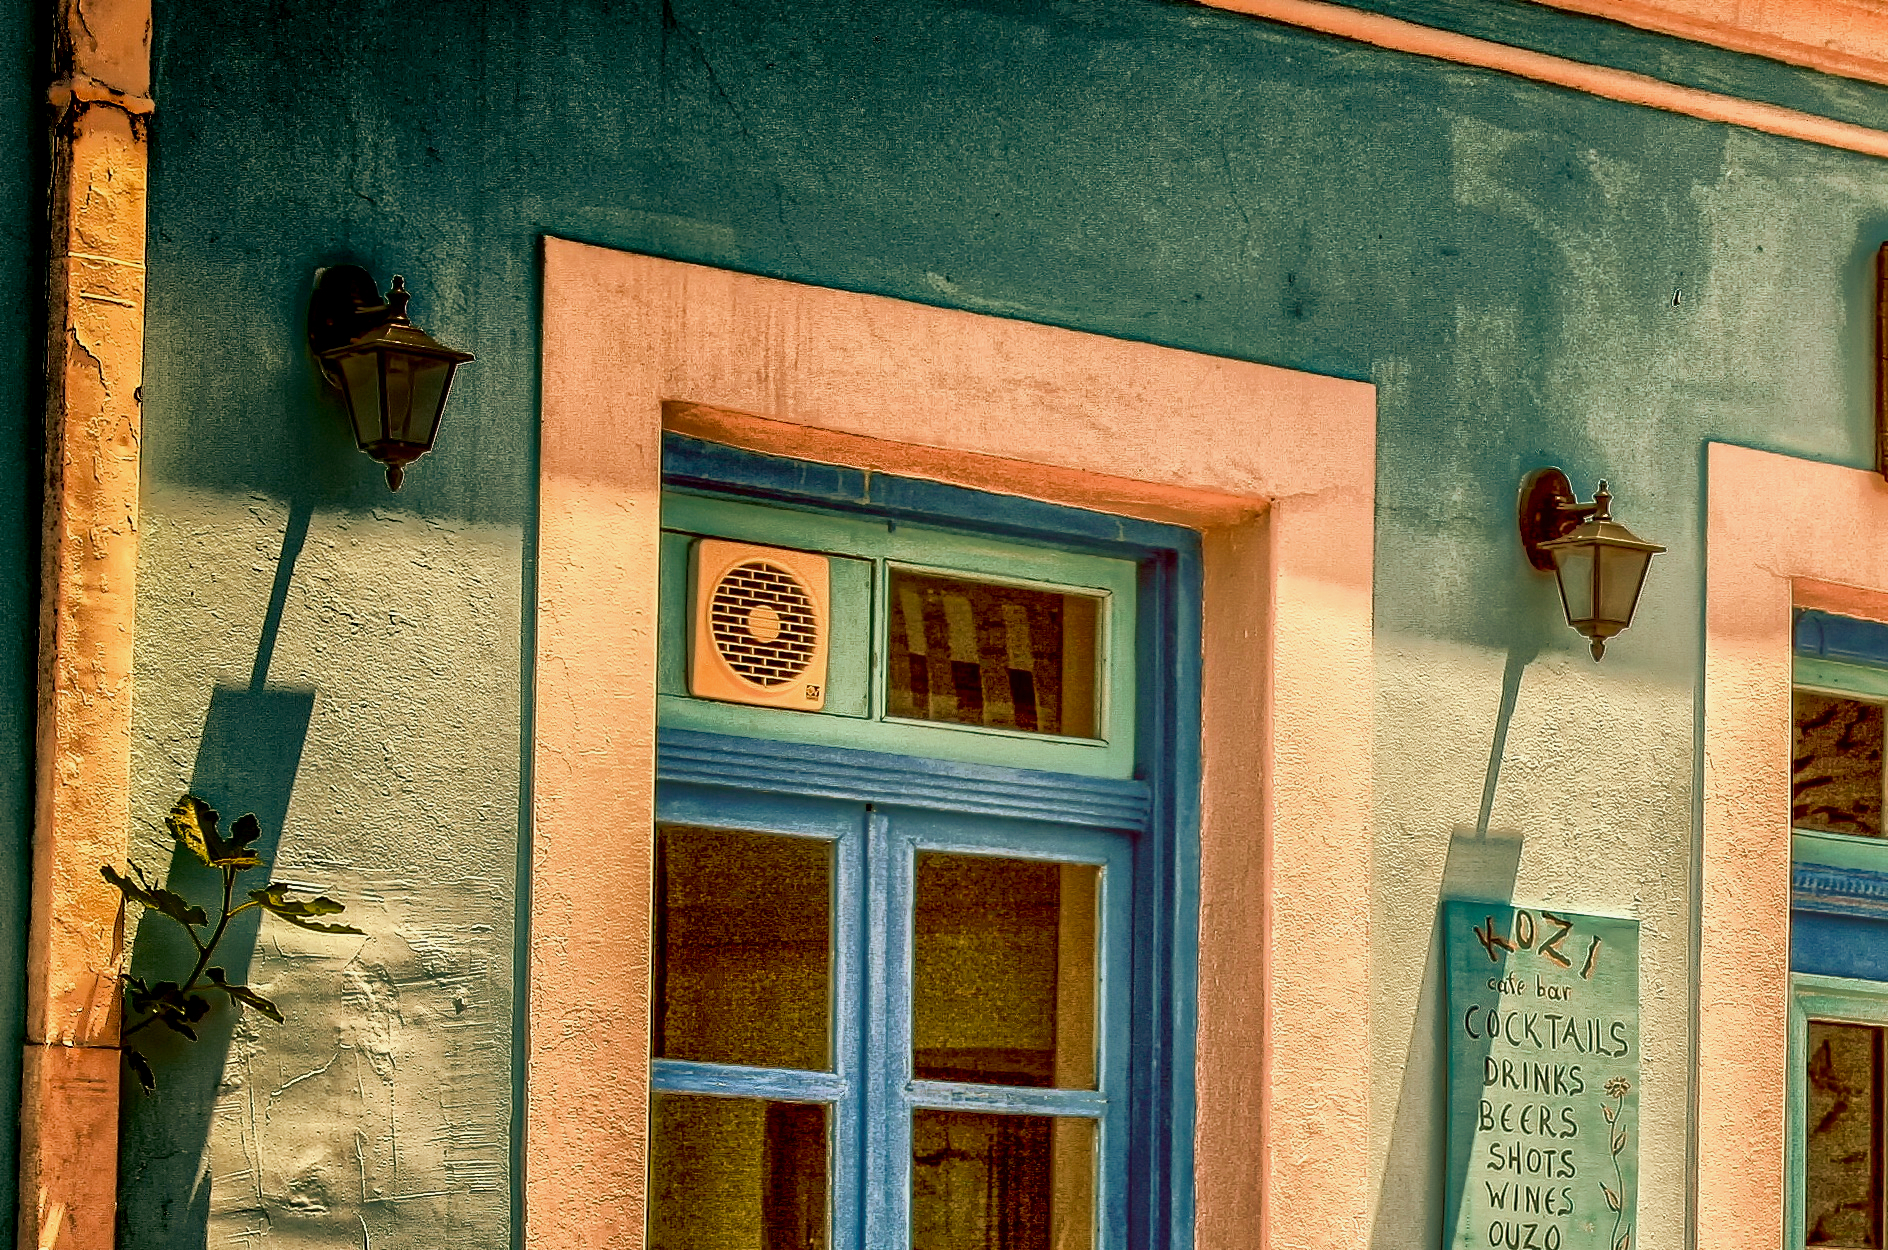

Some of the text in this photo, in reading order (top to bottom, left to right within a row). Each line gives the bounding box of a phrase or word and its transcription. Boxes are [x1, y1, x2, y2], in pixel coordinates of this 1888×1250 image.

[1472, 909, 1601, 980] KOZI
[1487, 971, 1572, 1000] cafe bar
[1465, 1004, 1629, 1058] COCKTAILS
[1483, 1055, 1586, 1096] DRINKS
[1478, 1100, 1578, 1139] BEERS
[1487, 1141, 1576, 1178] SHOTS
[1485, 1181, 1574, 1216] WINES
